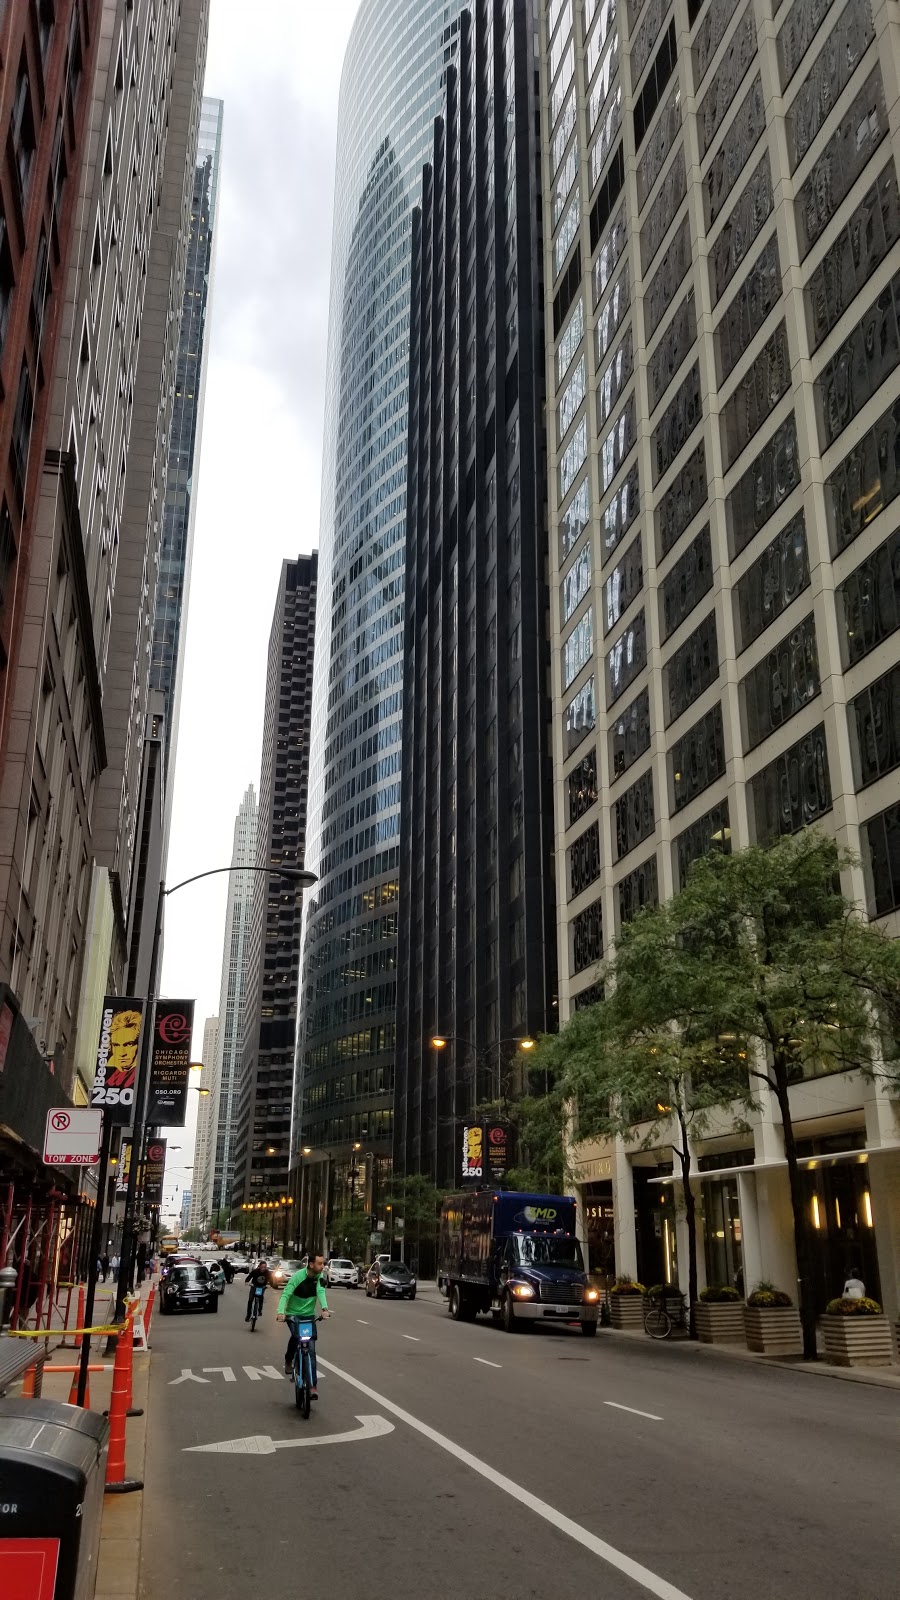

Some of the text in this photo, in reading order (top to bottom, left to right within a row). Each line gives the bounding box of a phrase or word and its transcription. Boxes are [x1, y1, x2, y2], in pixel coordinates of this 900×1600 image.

[94, 1008, 113, 1087] Beethoven
[92, 1087, 134, 1105] 250
[116, 1142, 127, 1182] Beethoven
[462, 1167, 482, 1176] 250
[116, 1182, 128, 1192] 25
[167, 1366, 326, 1385] NLY
[0, 1504, 18, 1513] OR
